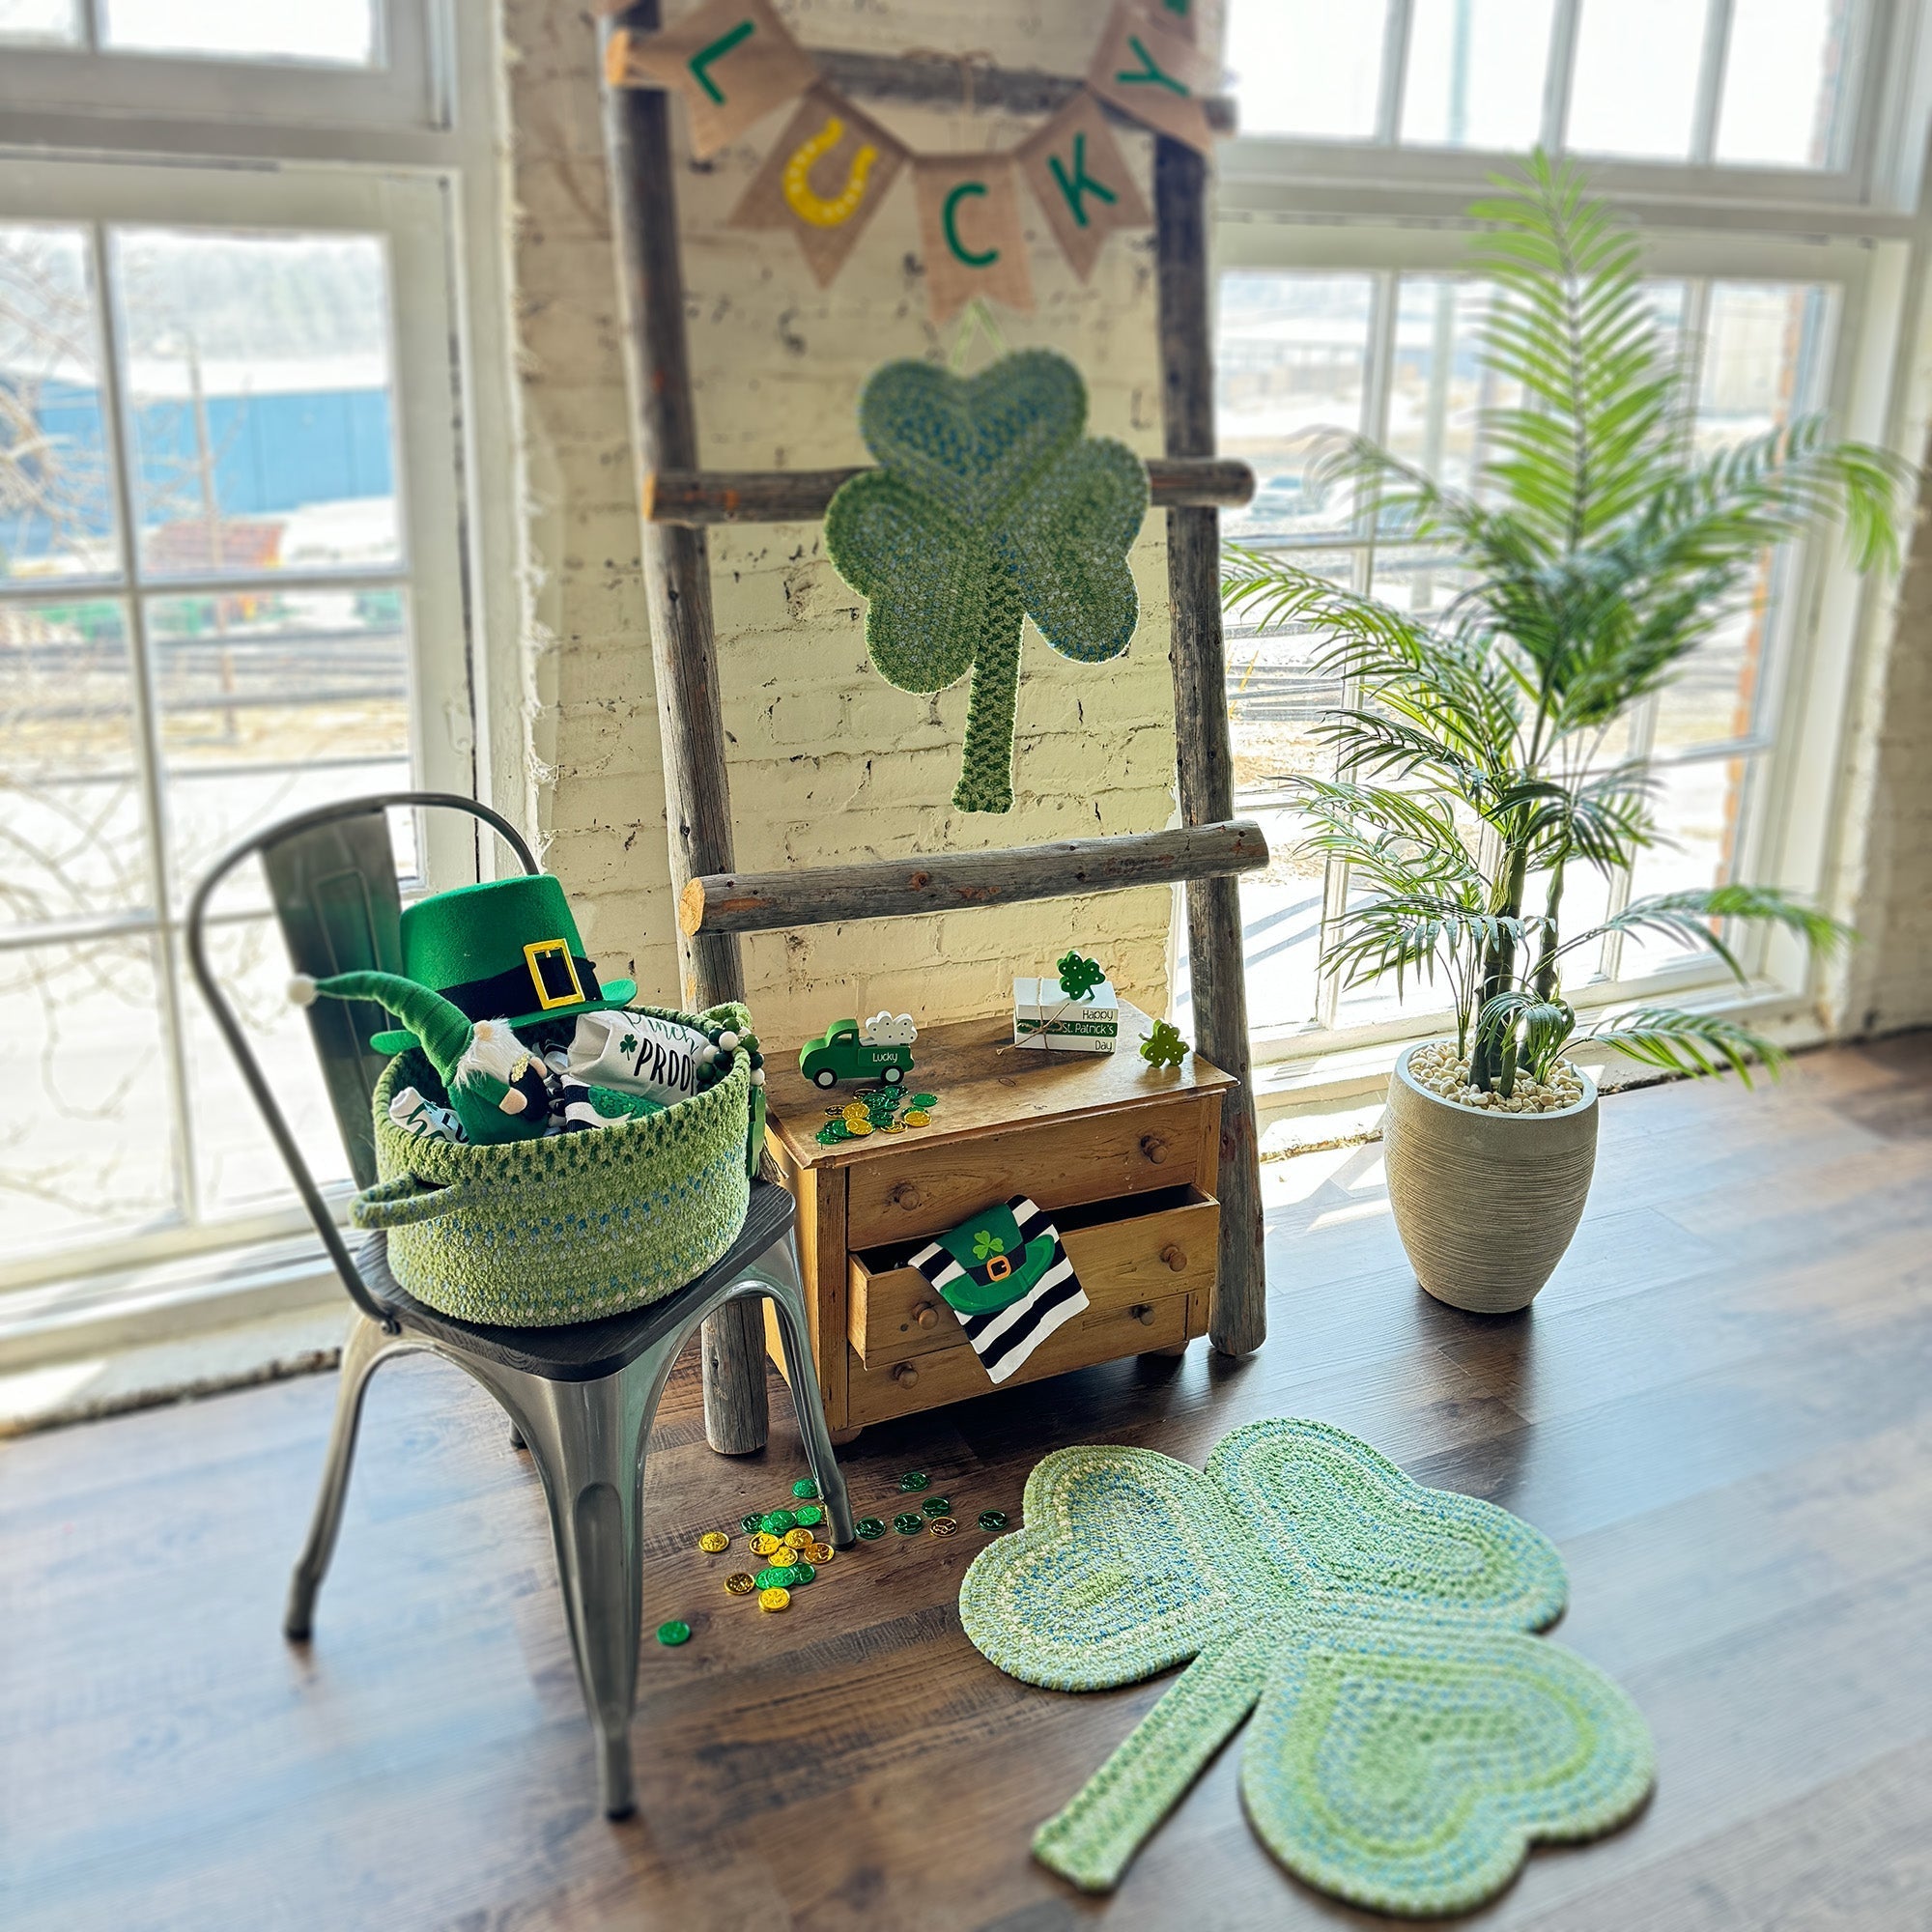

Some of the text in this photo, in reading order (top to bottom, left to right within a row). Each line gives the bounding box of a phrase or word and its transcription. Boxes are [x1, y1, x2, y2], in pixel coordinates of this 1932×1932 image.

[1082, 1009, 1113, 1021] Happy
[1062, 1022, 1114, 1035] St. Patrick's
[1094, 1039, 1113, 1052] Day
[872, 1052, 897, 1064] Lucky
